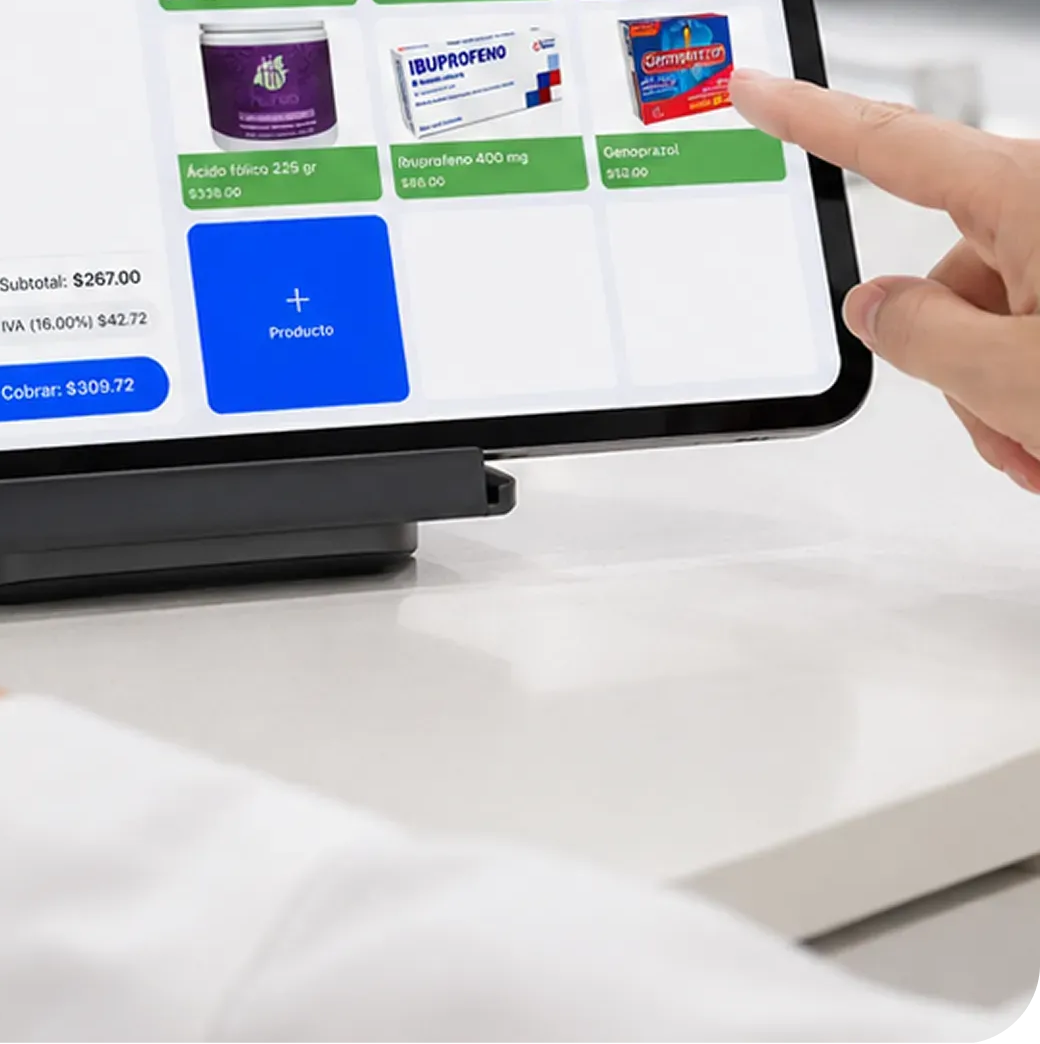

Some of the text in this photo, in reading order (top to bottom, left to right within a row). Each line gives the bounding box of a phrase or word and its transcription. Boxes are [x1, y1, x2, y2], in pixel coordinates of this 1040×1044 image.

[408, 44, 507, 76] IBUPROFENO
[474, 151, 505, 165] 400
[506, 152, 530, 166] mg
[602, 142, 680, 159] Genoprazol
[186, 162, 227, 179] Ácido
[302, 161, 317, 177] gr
[71, 269, 142, 288] $267.00
[0, 311, 148, 334] IVA (16.00%) $42.72
[268, 323, 335, 340] Producto
[0, 377, 135, 401] Cobrar: $309.72
